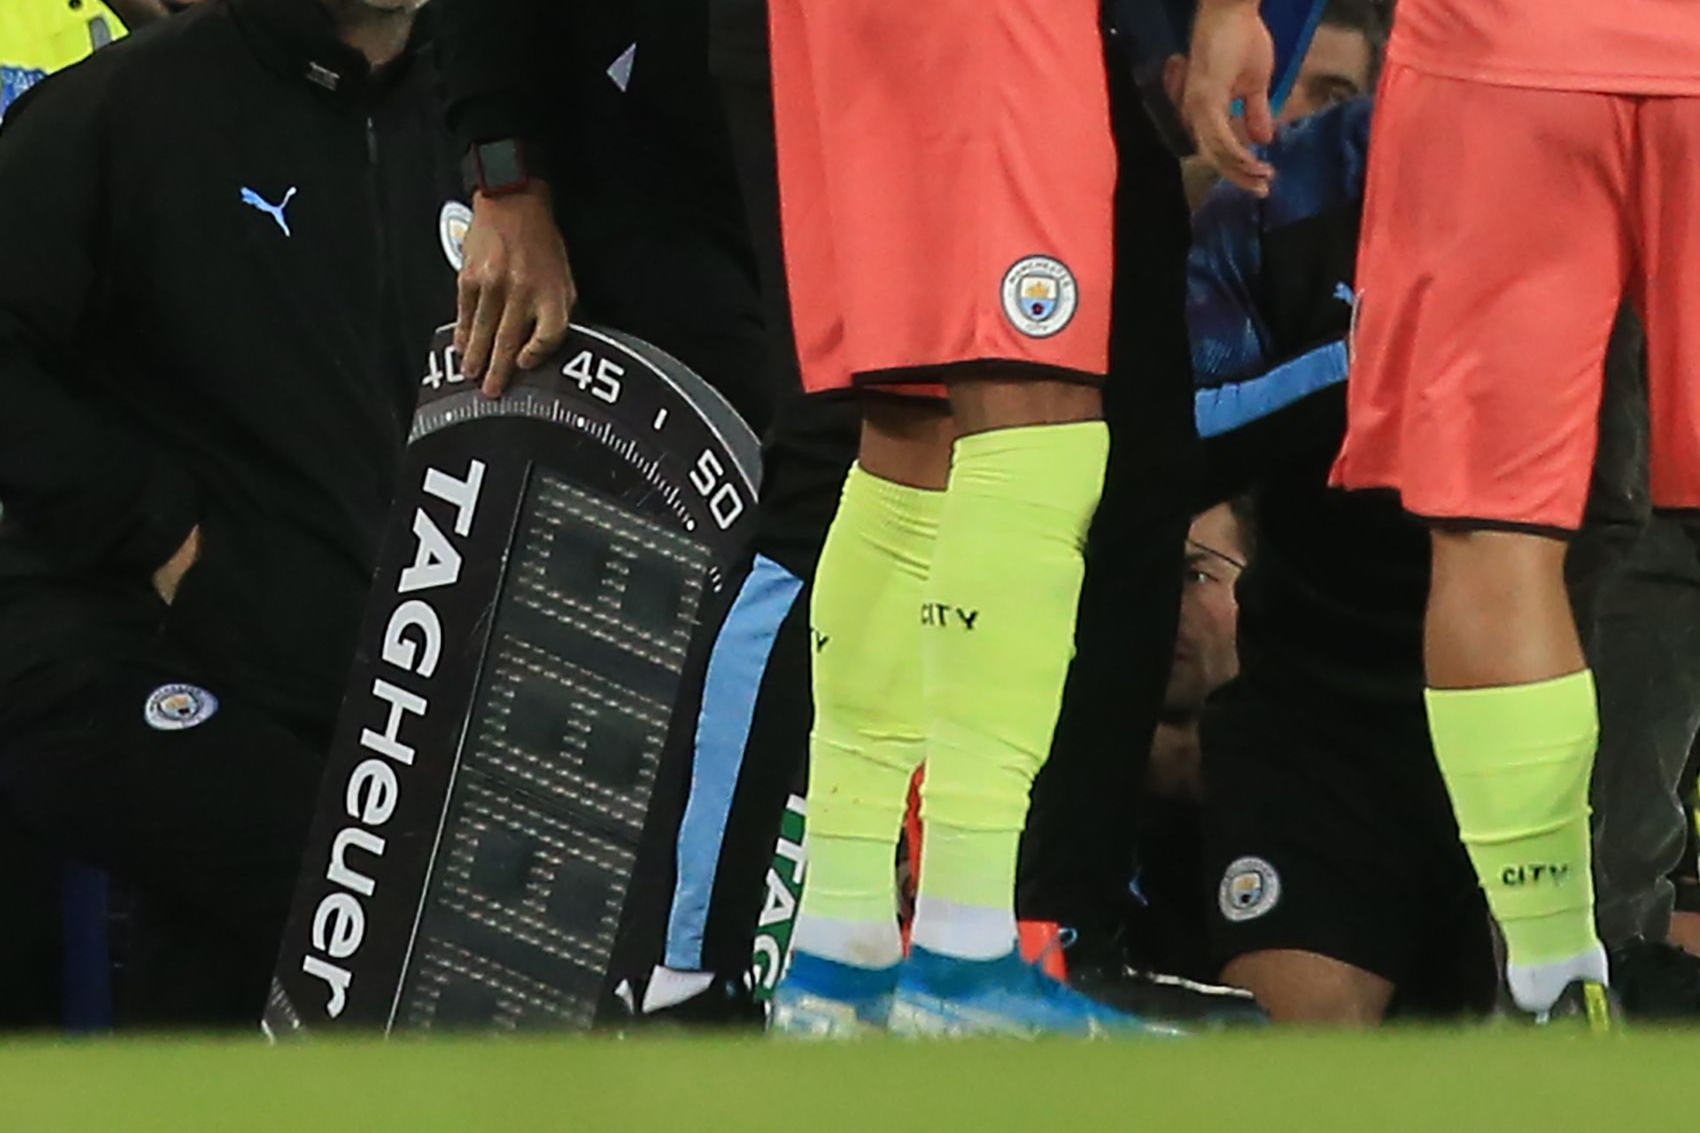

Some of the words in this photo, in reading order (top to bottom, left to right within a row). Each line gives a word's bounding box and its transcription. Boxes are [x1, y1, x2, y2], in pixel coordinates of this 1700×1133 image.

[562, 349, 625, 404] 45
[688, 448, 744, 531] 50
[921, 603, 979, 630] CITY
[1502, 863, 1568, 887] CITY
